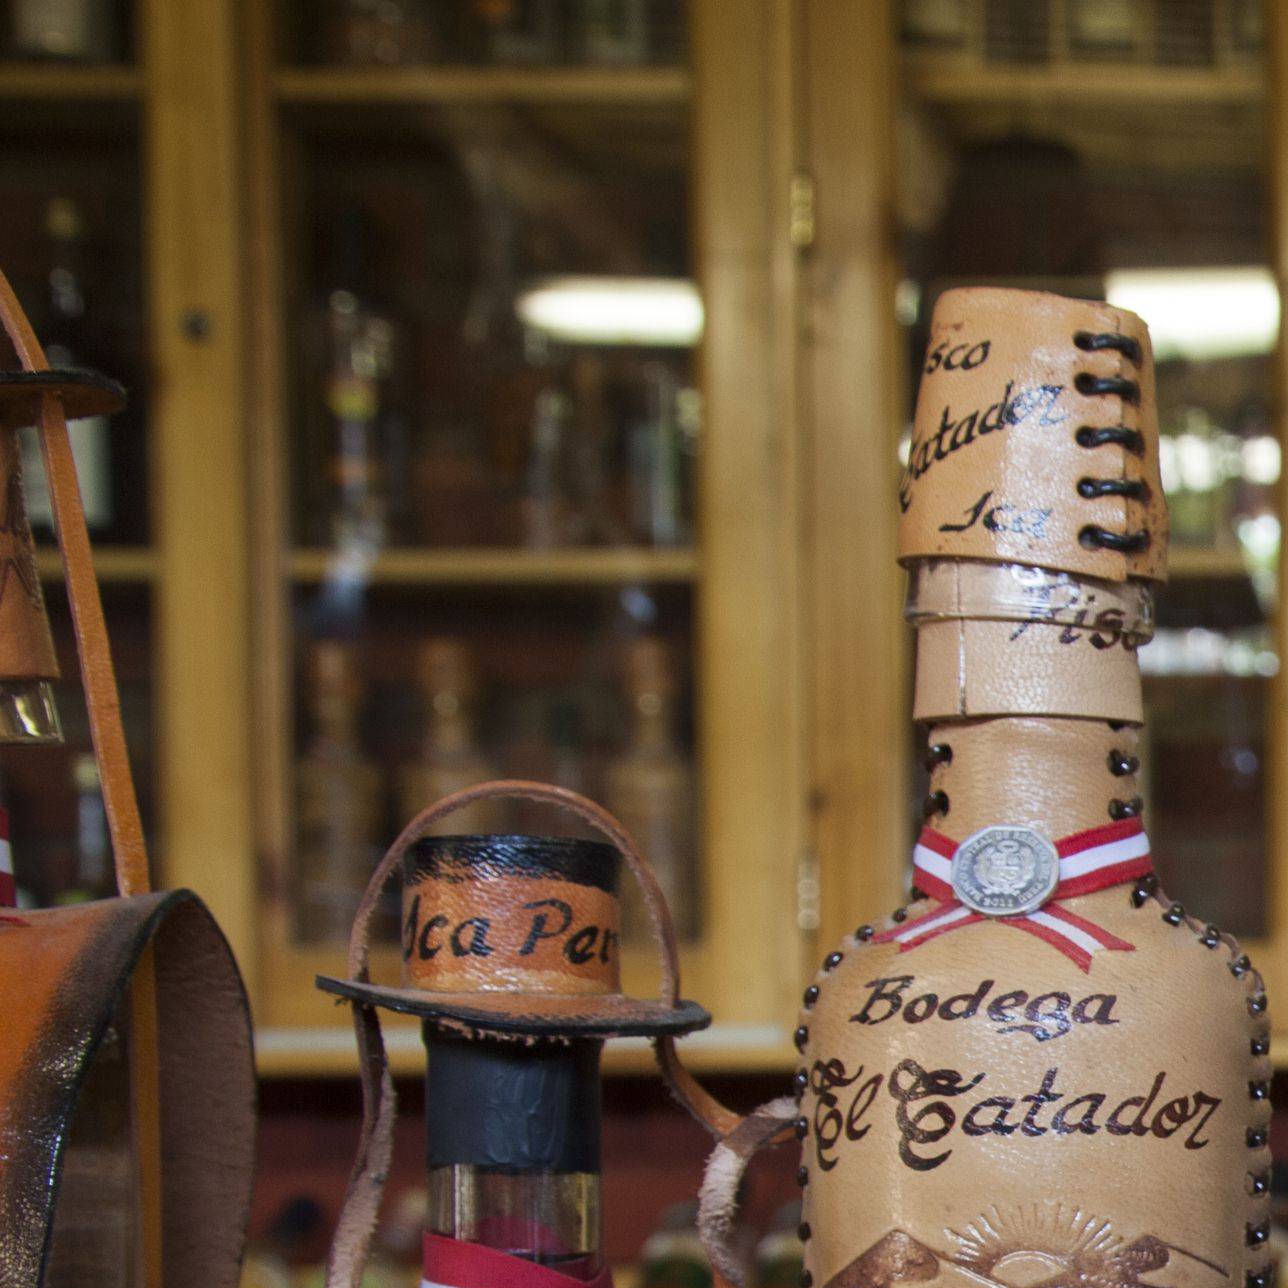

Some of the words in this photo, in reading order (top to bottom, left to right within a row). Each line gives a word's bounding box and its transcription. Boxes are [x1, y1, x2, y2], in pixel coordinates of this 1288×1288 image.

[519, 898, 617, 965] Per
[848, 973, 1120, 1043] Bodega
[809, 1057, 885, 1172] El
[888, 1058, 1222, 1172] Catador
